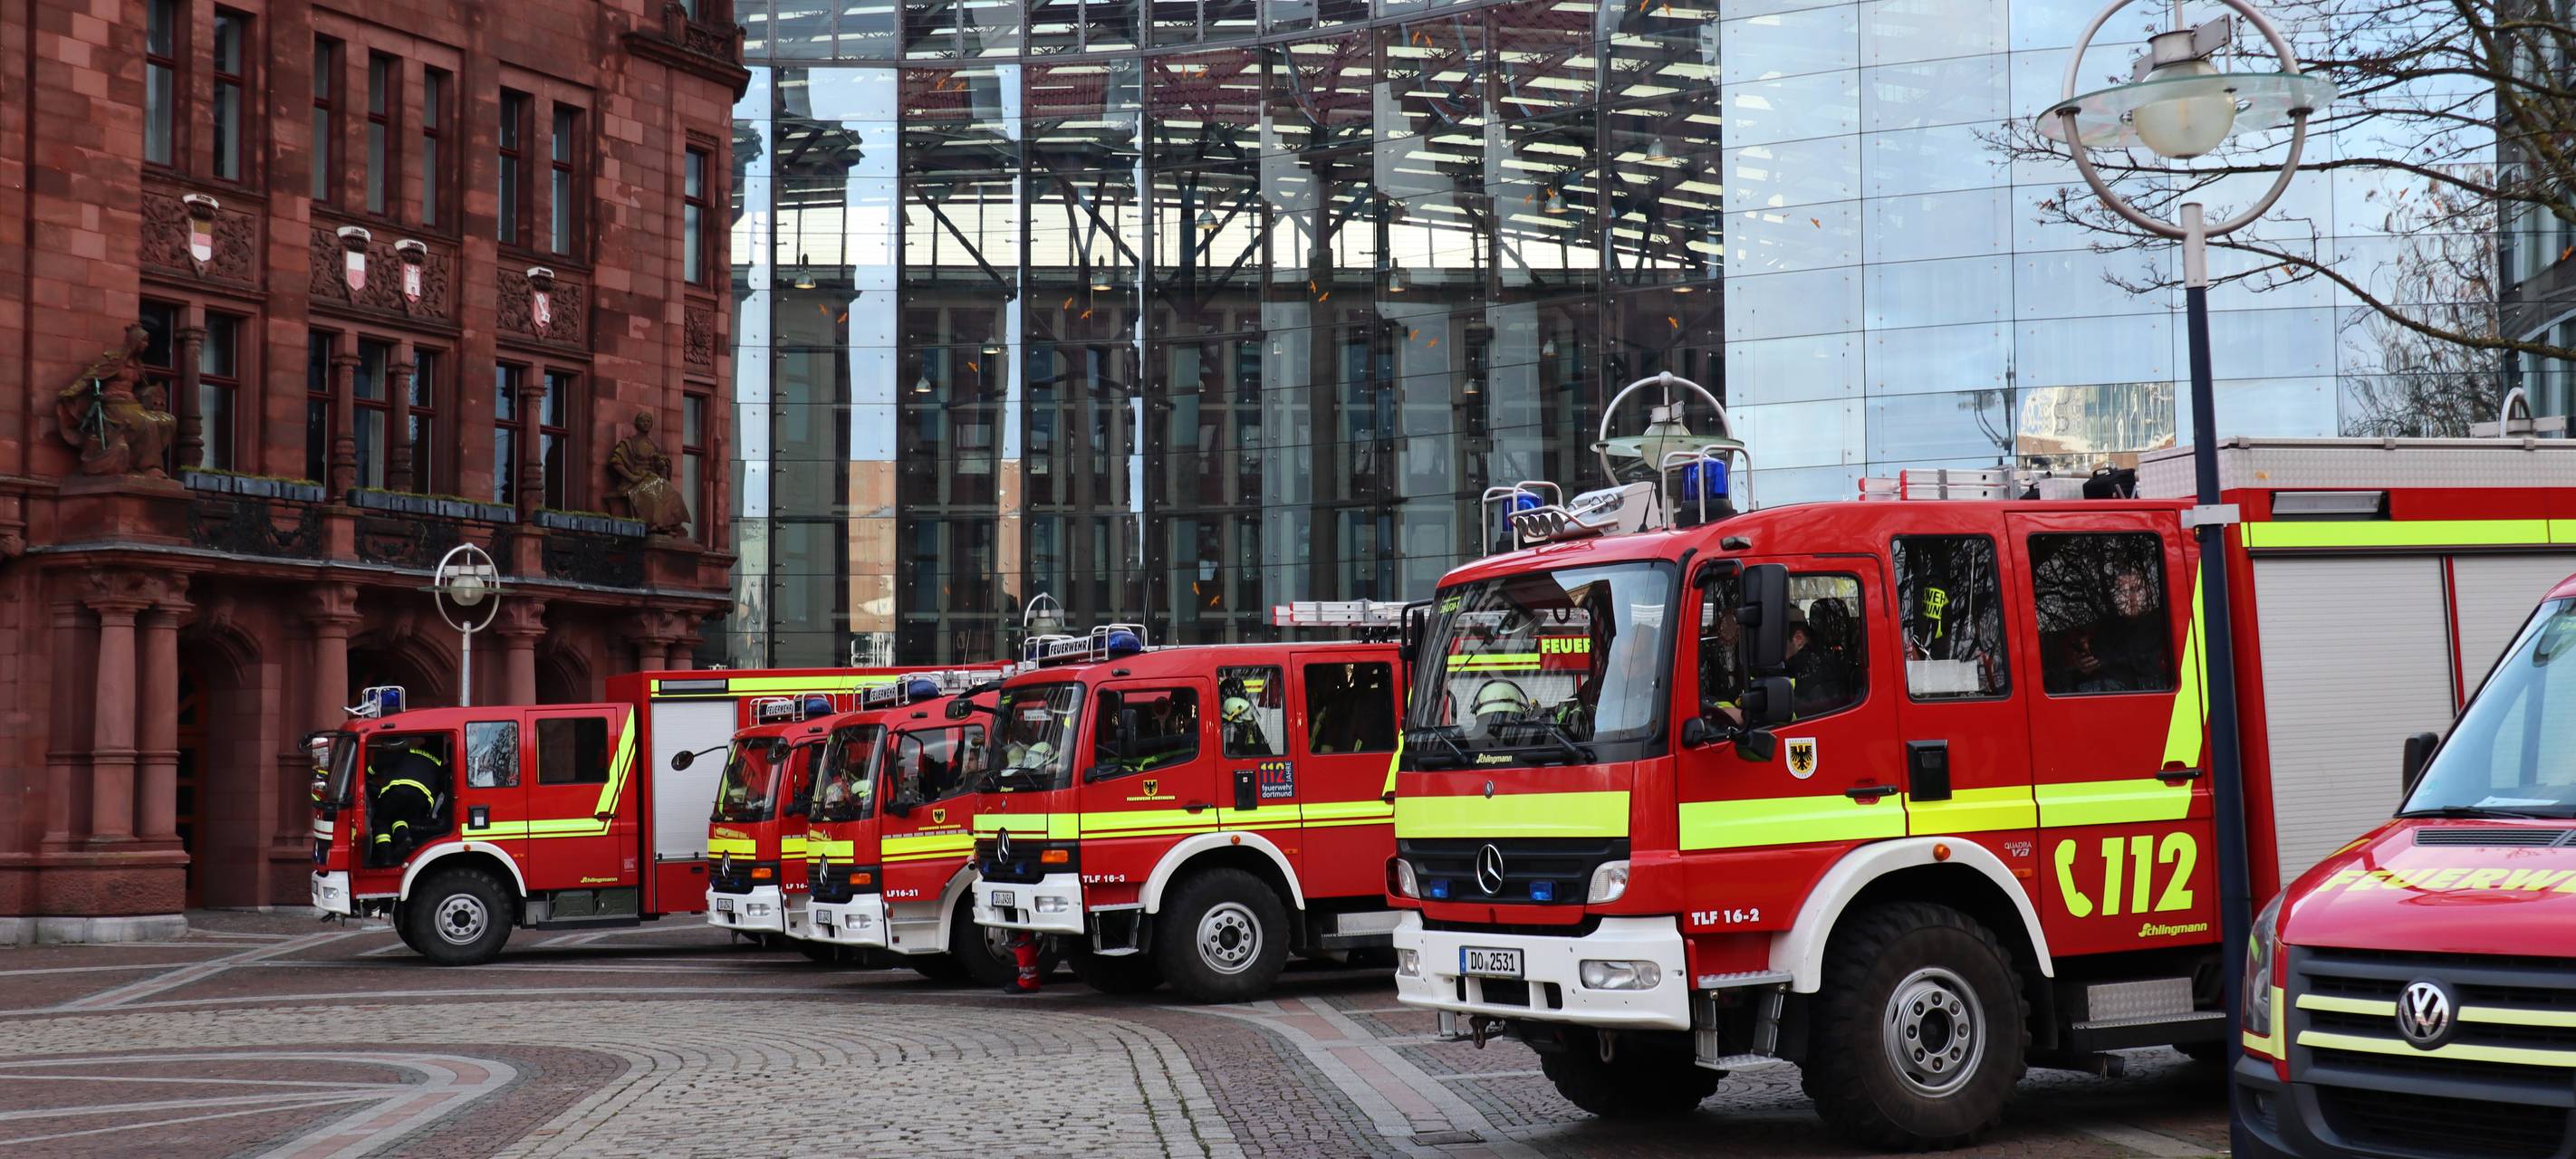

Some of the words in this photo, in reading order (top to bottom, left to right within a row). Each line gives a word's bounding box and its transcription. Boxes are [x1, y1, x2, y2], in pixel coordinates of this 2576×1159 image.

[1051, 639, 1088, 655] FEUERWEHR
[870, 686, 896, 700] FEUERWEHR
[766, 702, 793, 715] FEUERWEHR
[1476, 752, 1513, 764] Schlingmann
[1260, 762, 1285, 783] 112
[1262, 783, 1293, 792] feuerwehr
[1262, 790, 1293, 798] dortmund
[2004, 841, 2033, 850] QUADRA
[1082, 875, 1101, 884] TLF
[1103, 874, 1125, 883] 16-3
[2101, 831, 2197, 916] 112
[1691, 910, 1718, 926] TLF
[1724, 907, 1760, 924] 16-2
[2138, 922, 2208, 938] Schlingmann
[1470, 952, 1484, 970] DO
[1490, 953, 1515, 972] 2531
